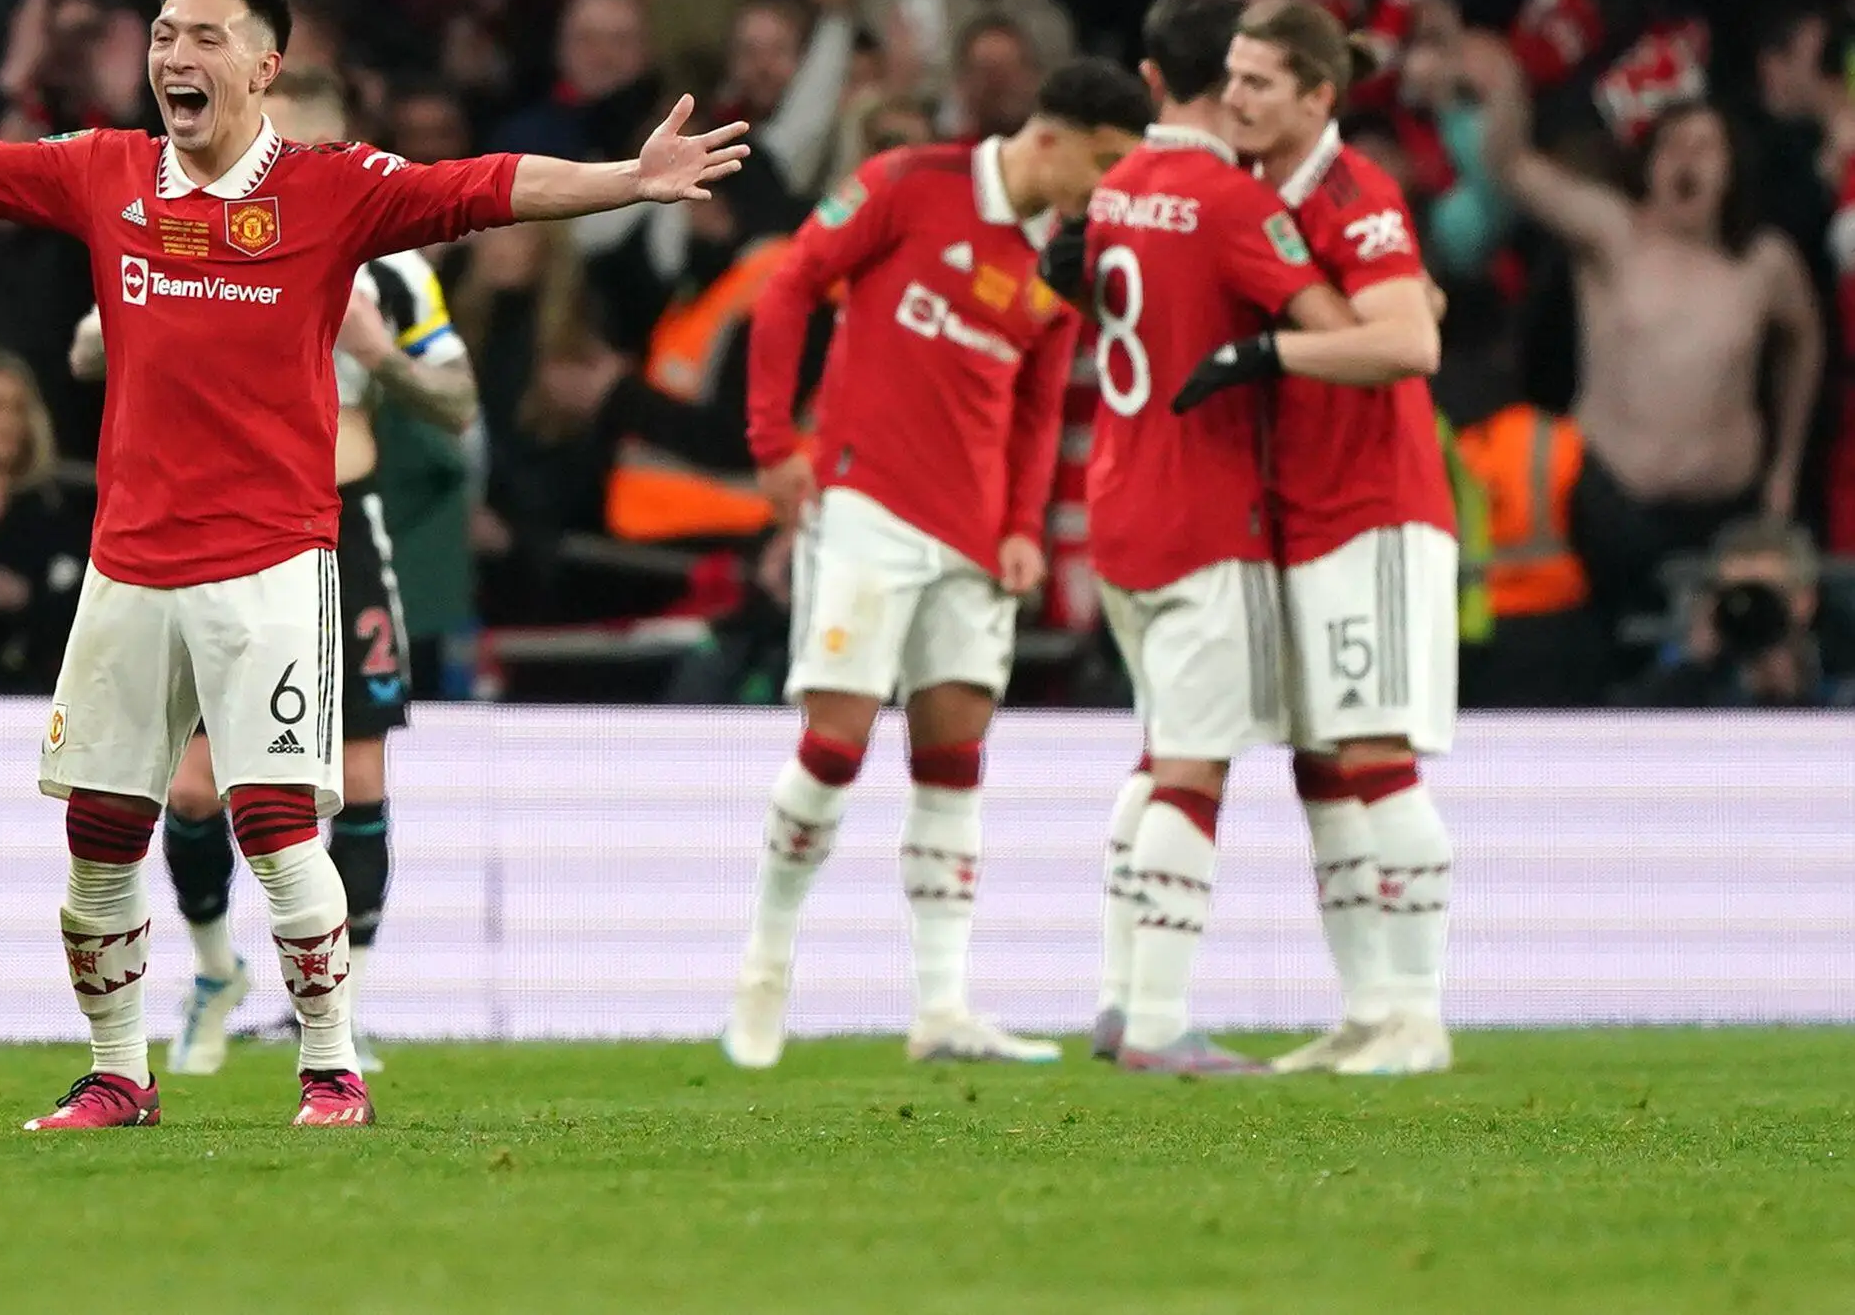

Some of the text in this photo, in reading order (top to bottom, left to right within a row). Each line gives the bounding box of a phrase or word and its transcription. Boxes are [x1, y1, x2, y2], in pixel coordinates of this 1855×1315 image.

[150, 272, 283, 305] TeamViewer
[1094, 245, 1152, 417] 8
[1326, 615, 1373, 680] 15
[270, 658, 307, 725] 6
[267, 743, 306, 754] adidas
